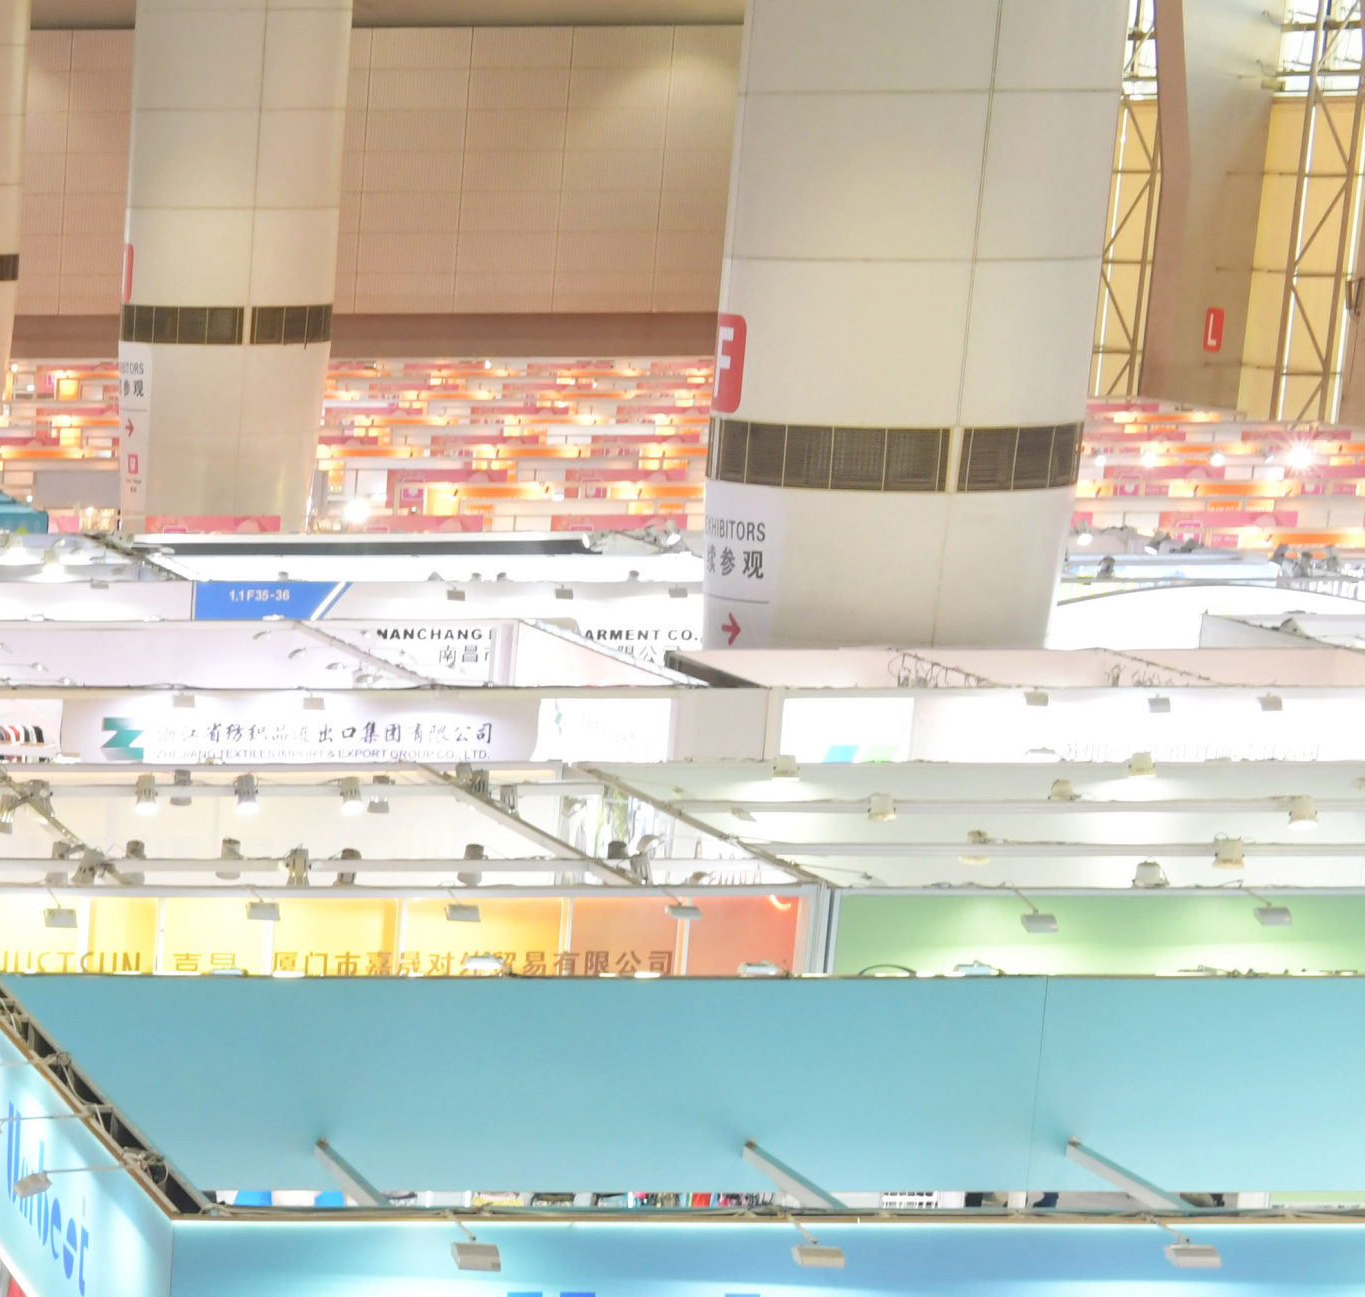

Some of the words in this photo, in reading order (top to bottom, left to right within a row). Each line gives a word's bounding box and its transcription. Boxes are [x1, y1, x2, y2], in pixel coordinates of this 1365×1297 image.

[1207, 312, 1218, 347] L
[377, 628, 483, 641] NANCHANG
[338, 749, 386, 760] EXPORT
